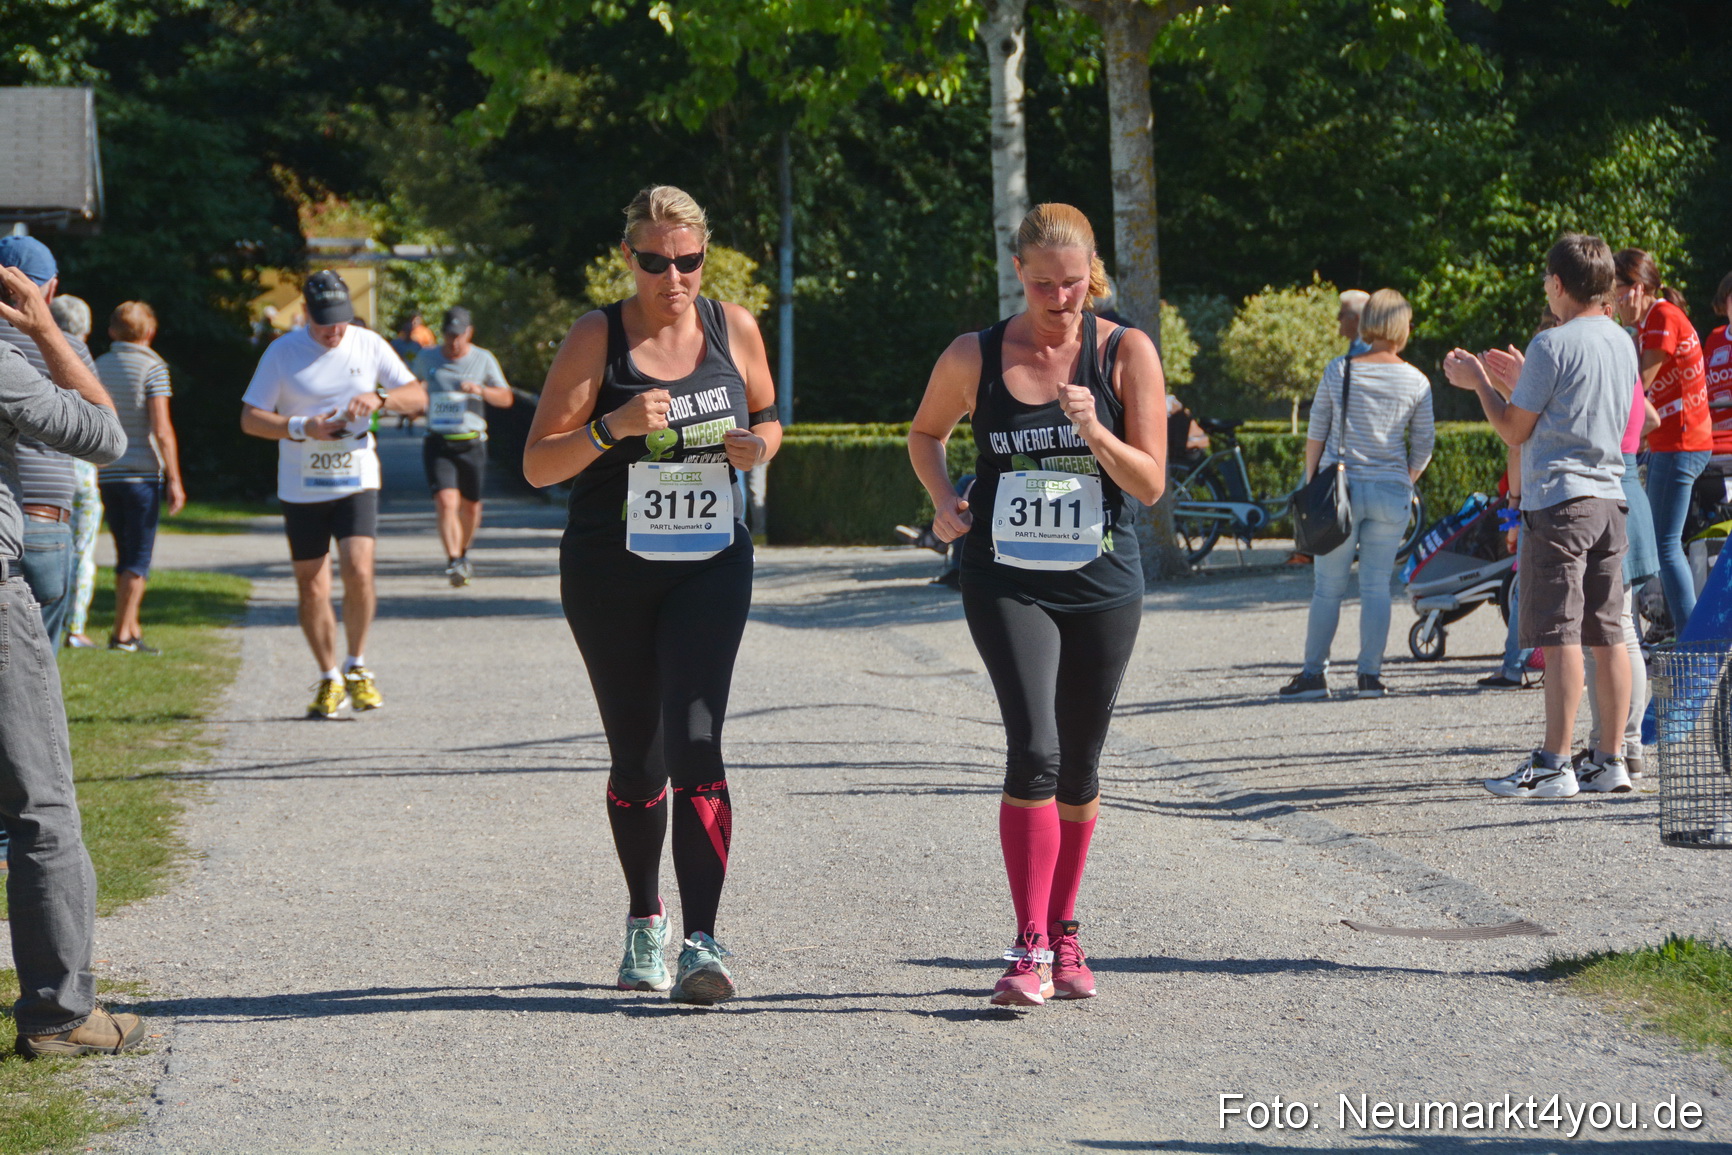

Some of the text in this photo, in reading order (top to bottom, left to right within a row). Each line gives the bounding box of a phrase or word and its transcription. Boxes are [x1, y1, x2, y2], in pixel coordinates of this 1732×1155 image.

[666, 386, 732, 422] ERDE NICHT
[989, 432, 1011, 454] ICH
[1011, 426, 1056, 453] WERDE
[310, 452, 353, 469] 2032
[659, 471, 702, 482] BOCK
[1026, 478, 1071, 491] BOCK
[644, 489, 717, 519] 3112
[1009, 497, 1081, 529] 3111
[650, 522, 703, 531] PARTL Neumarkt
